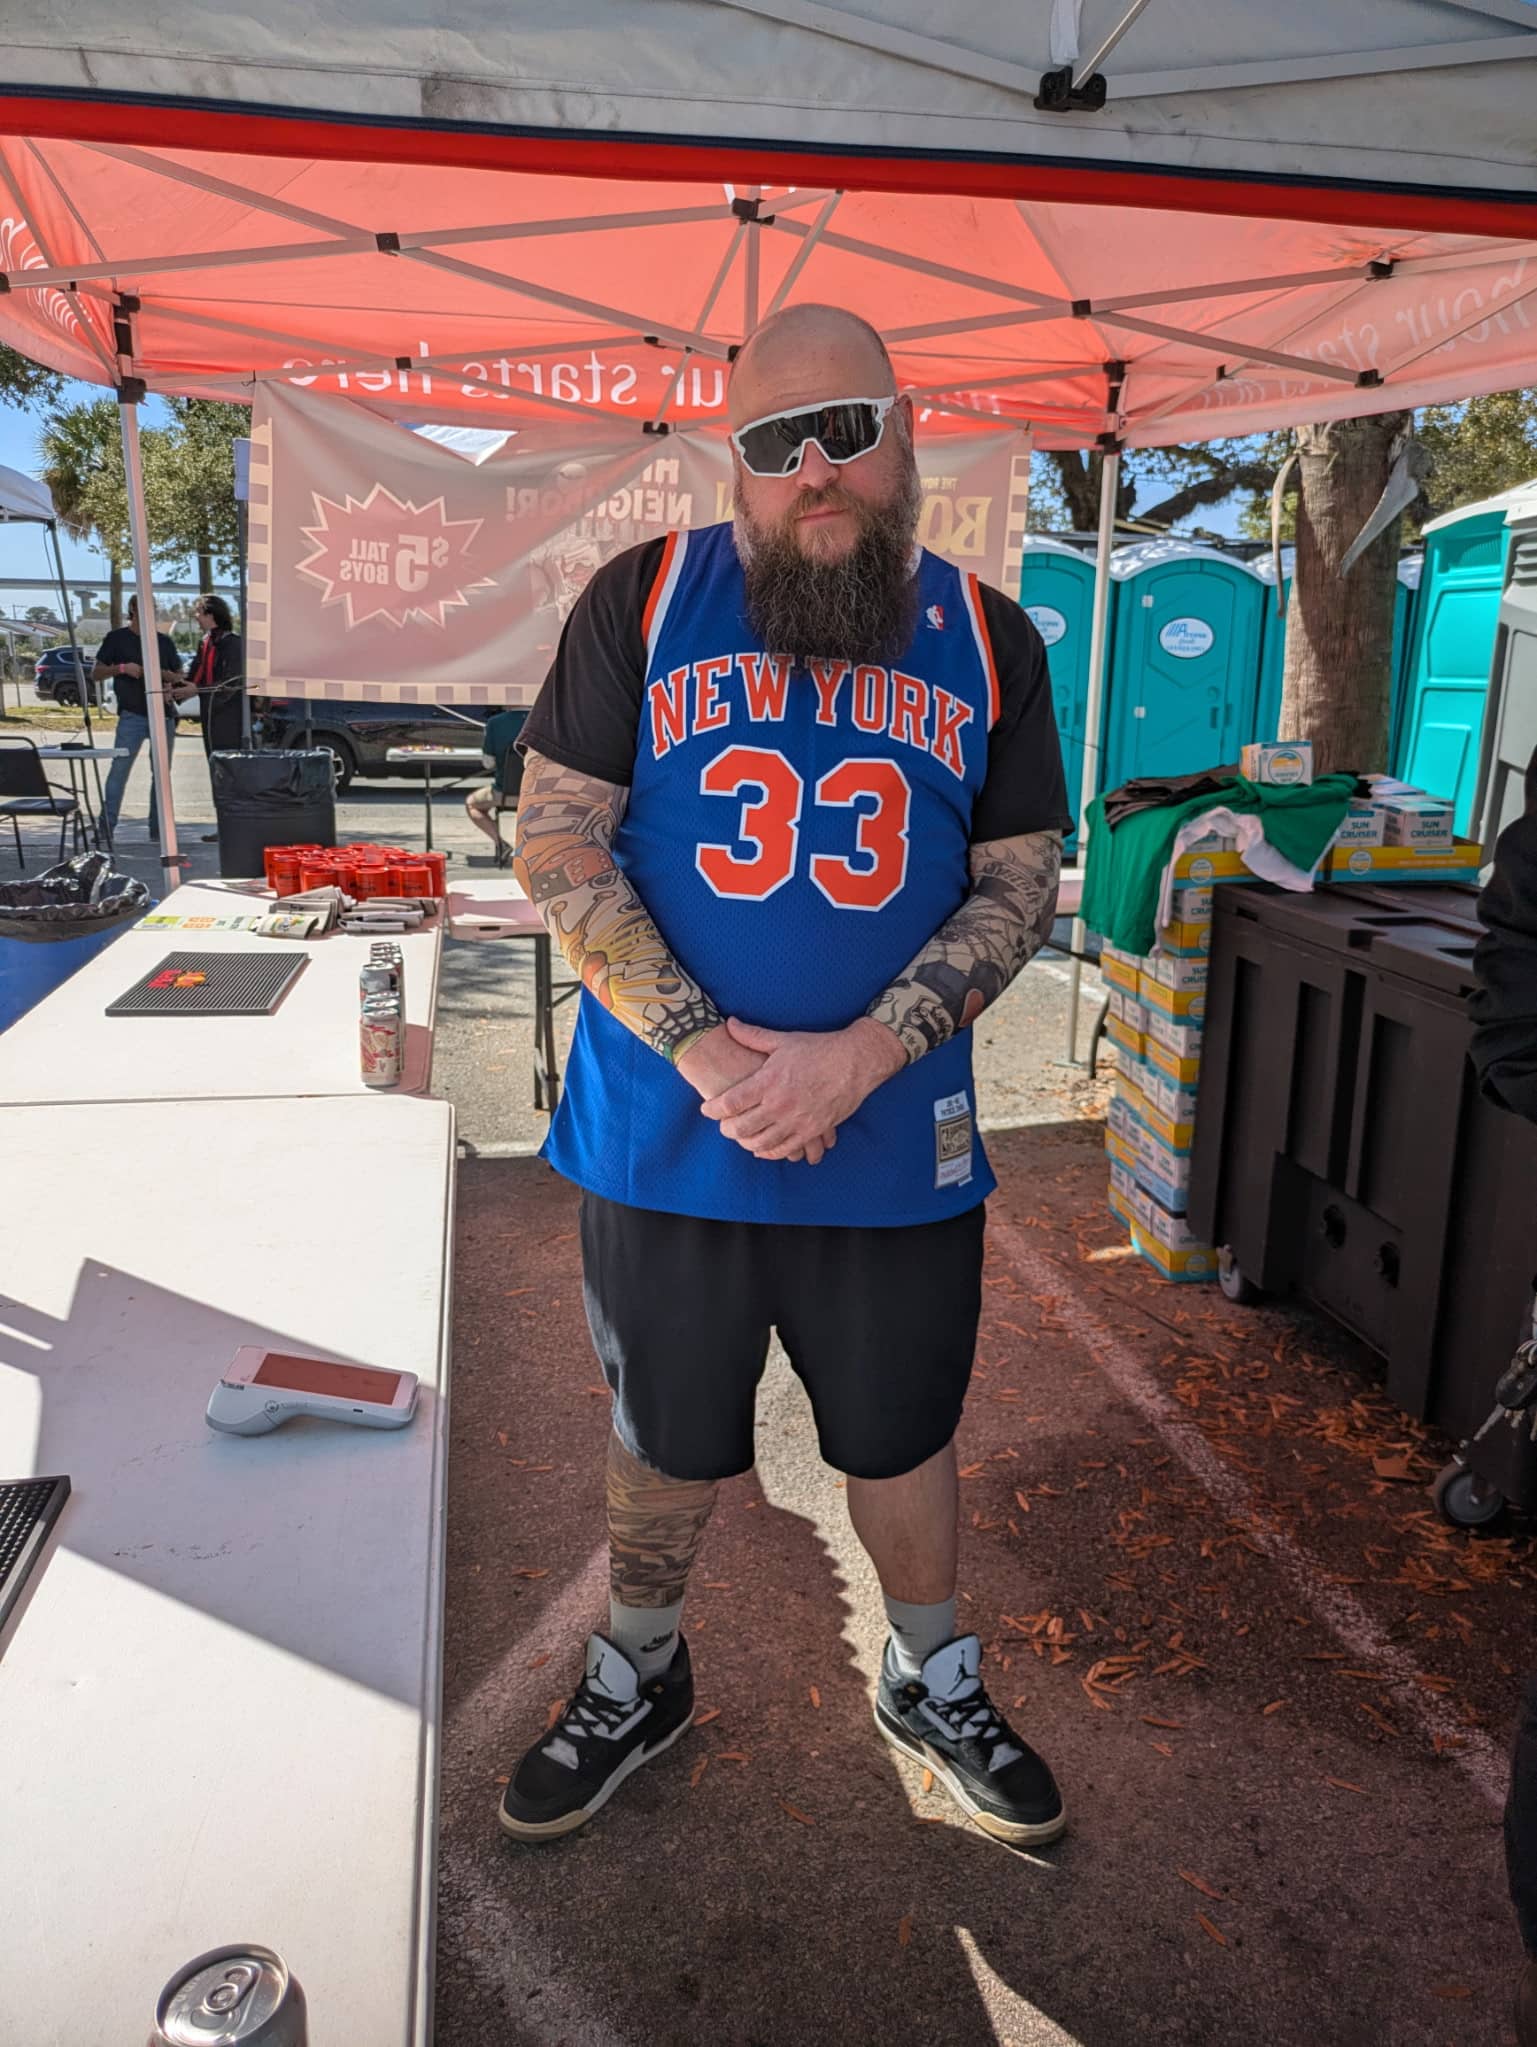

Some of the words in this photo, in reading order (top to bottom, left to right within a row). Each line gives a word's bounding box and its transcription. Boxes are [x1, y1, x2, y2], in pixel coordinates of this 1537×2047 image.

[648, 652, 796, 761] NEW
[805, 655, 974, 782] YORK
[694, 744, 912, 912] 33
[1351, 821, 1370, 829] SUN
[1421, 820, 1441, 829] SUN
